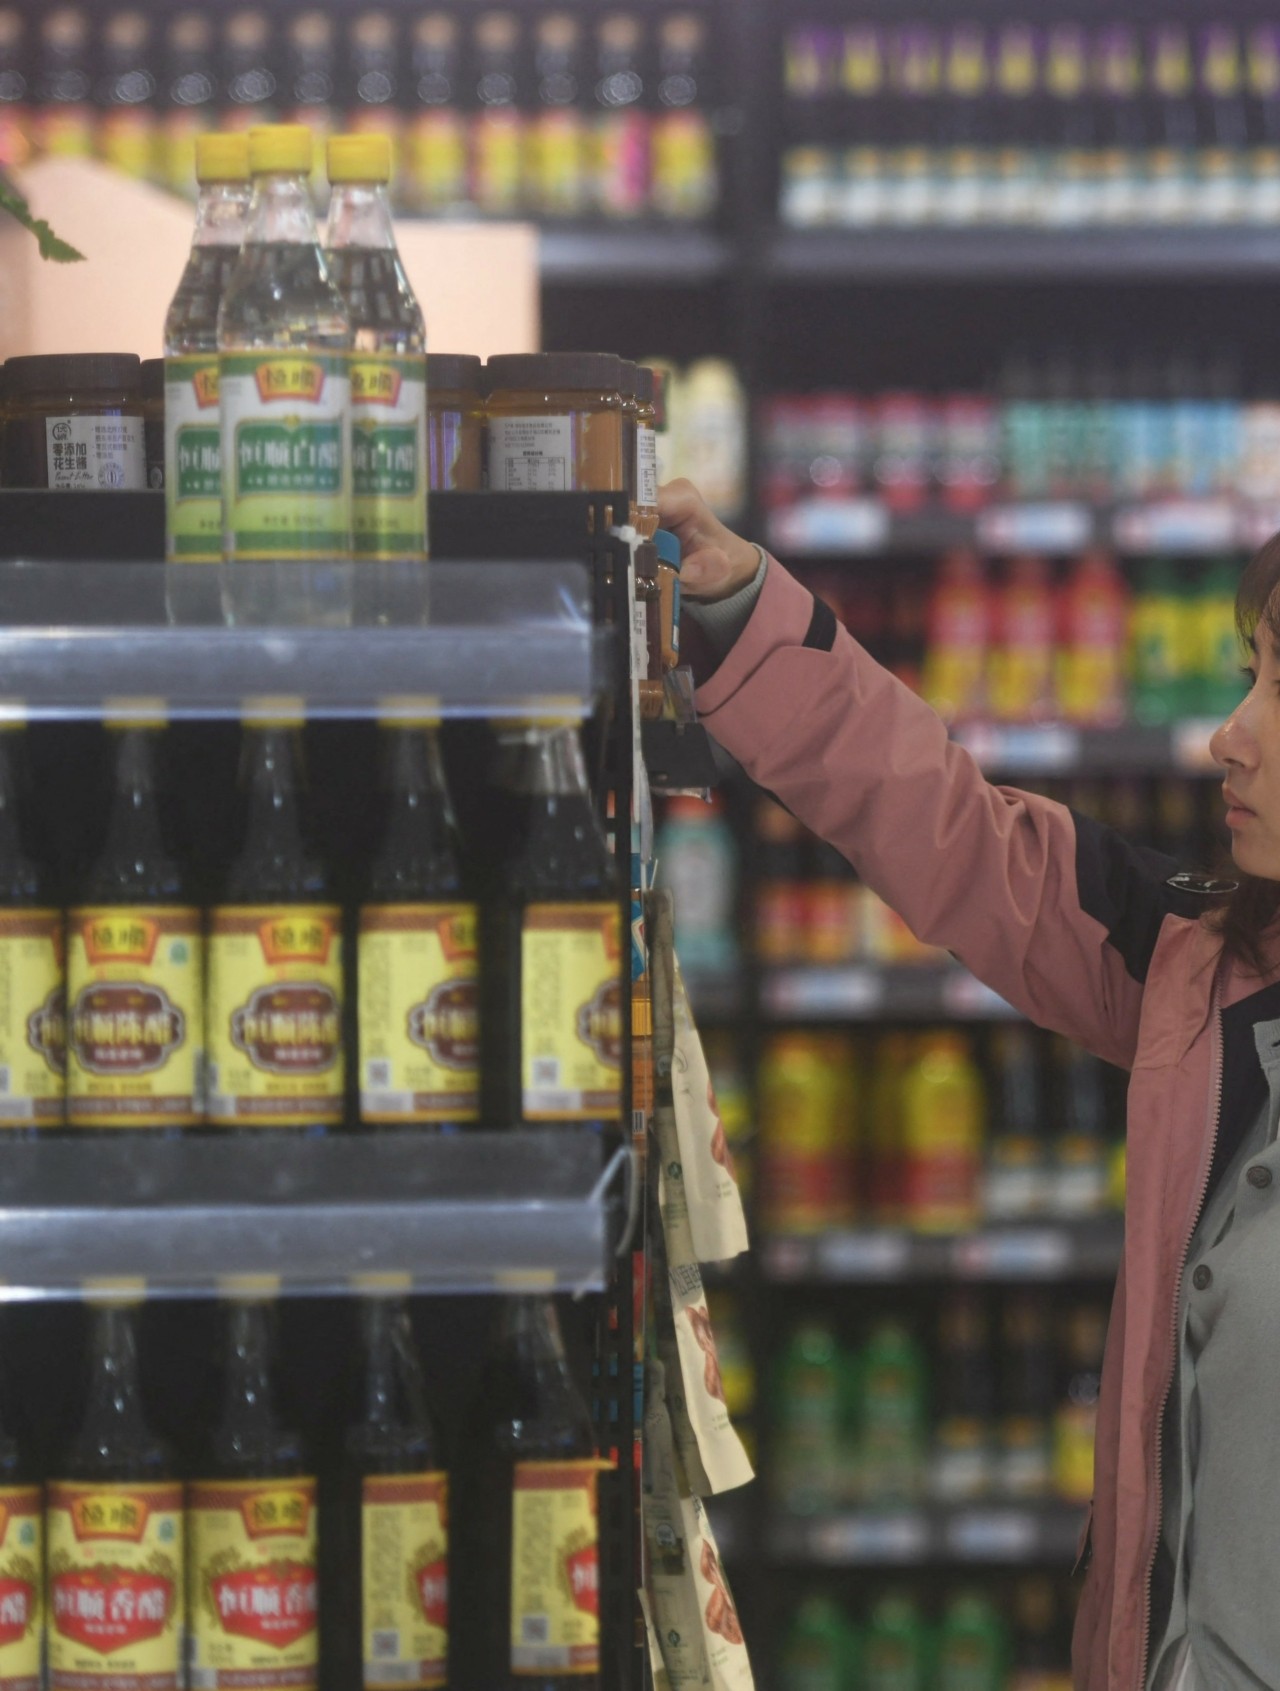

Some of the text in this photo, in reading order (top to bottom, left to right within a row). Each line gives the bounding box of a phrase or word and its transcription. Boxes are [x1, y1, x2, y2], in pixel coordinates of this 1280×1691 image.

[53, 442, 87, 456] 零添加
[54, 1586, 166, 1622] 恒顺香醋
